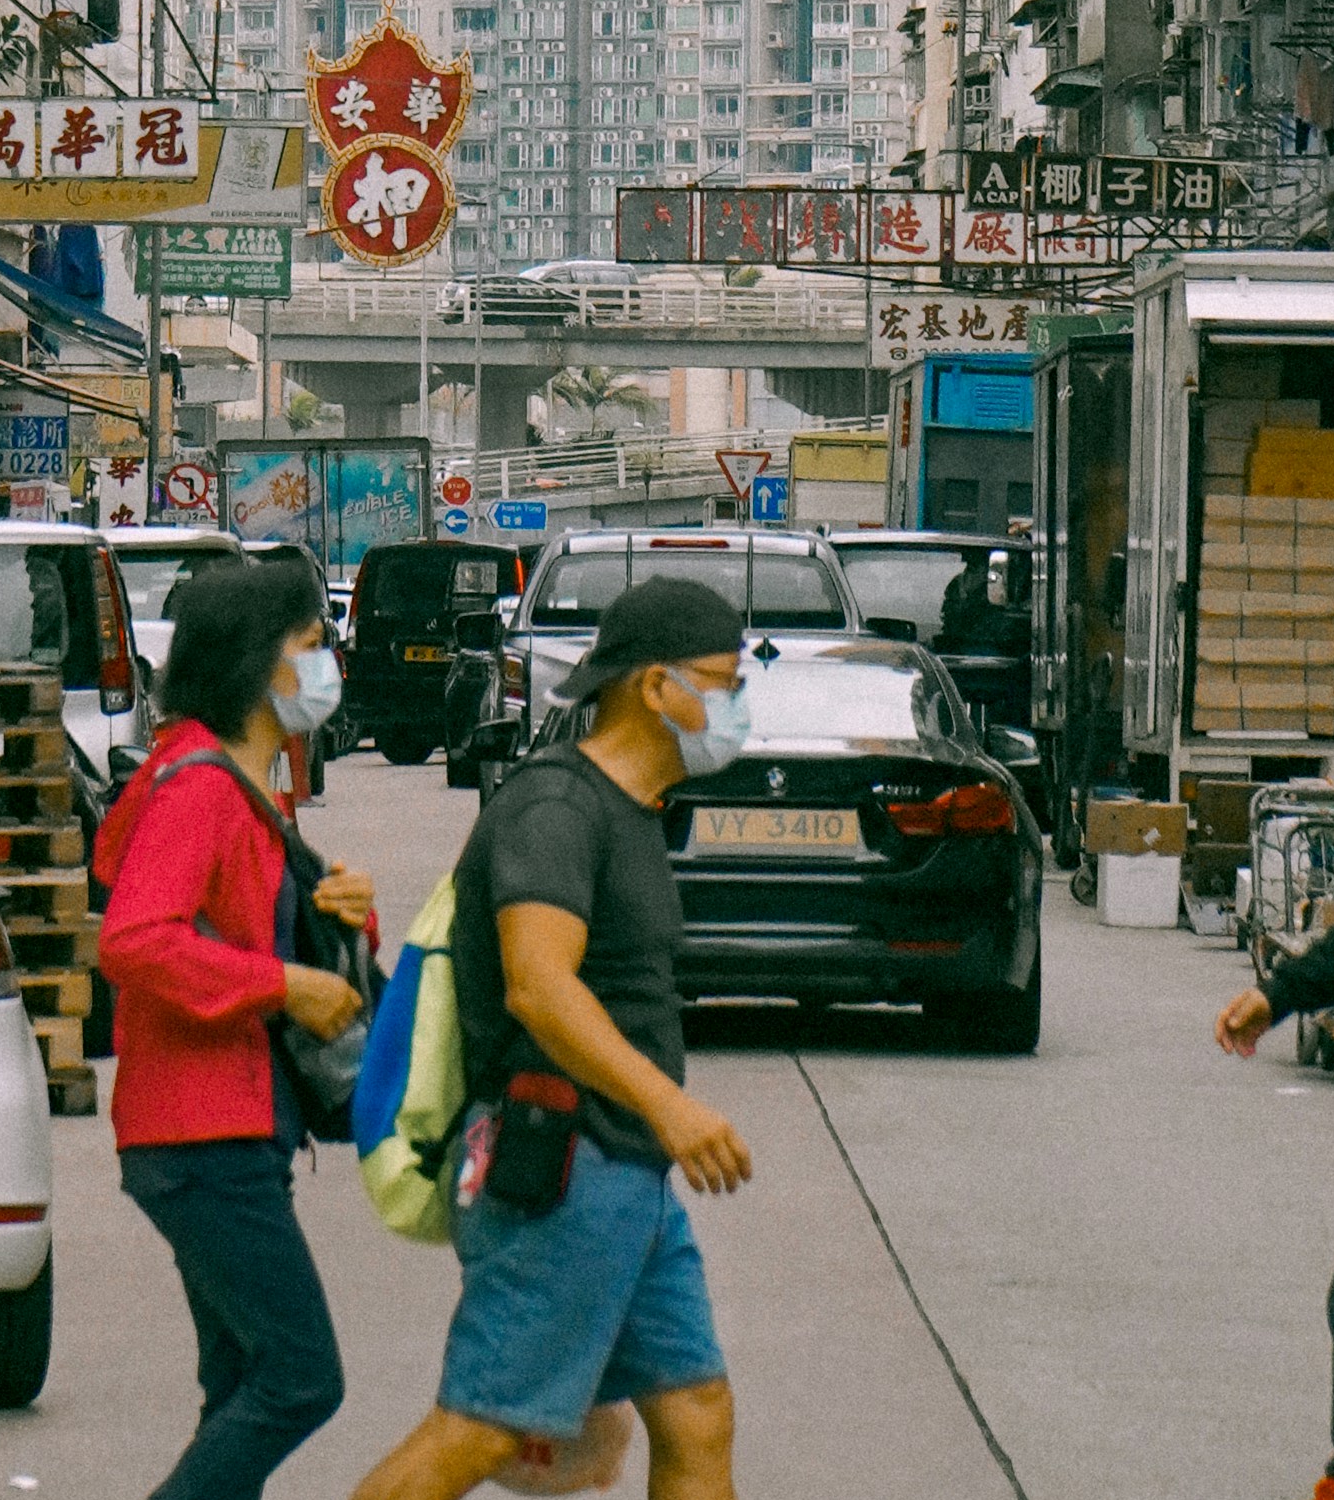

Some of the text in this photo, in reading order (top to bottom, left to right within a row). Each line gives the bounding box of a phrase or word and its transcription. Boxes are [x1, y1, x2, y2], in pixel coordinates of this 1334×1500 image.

[983, 161, 1010, 189] A
[1041, 162, 1214, 210] 椰子油
[347, 152, 431, 250] 押
[972, 189, 1020, 205] A CAP
[878, 303, 1028, 343] 宏基地產
[10, 451, 64, 475] 0228
[343, 489, 407, 518] EDIBLE
[381, 504, 413, 526] ICE
[708, 813, 844, 839] VY 3410
